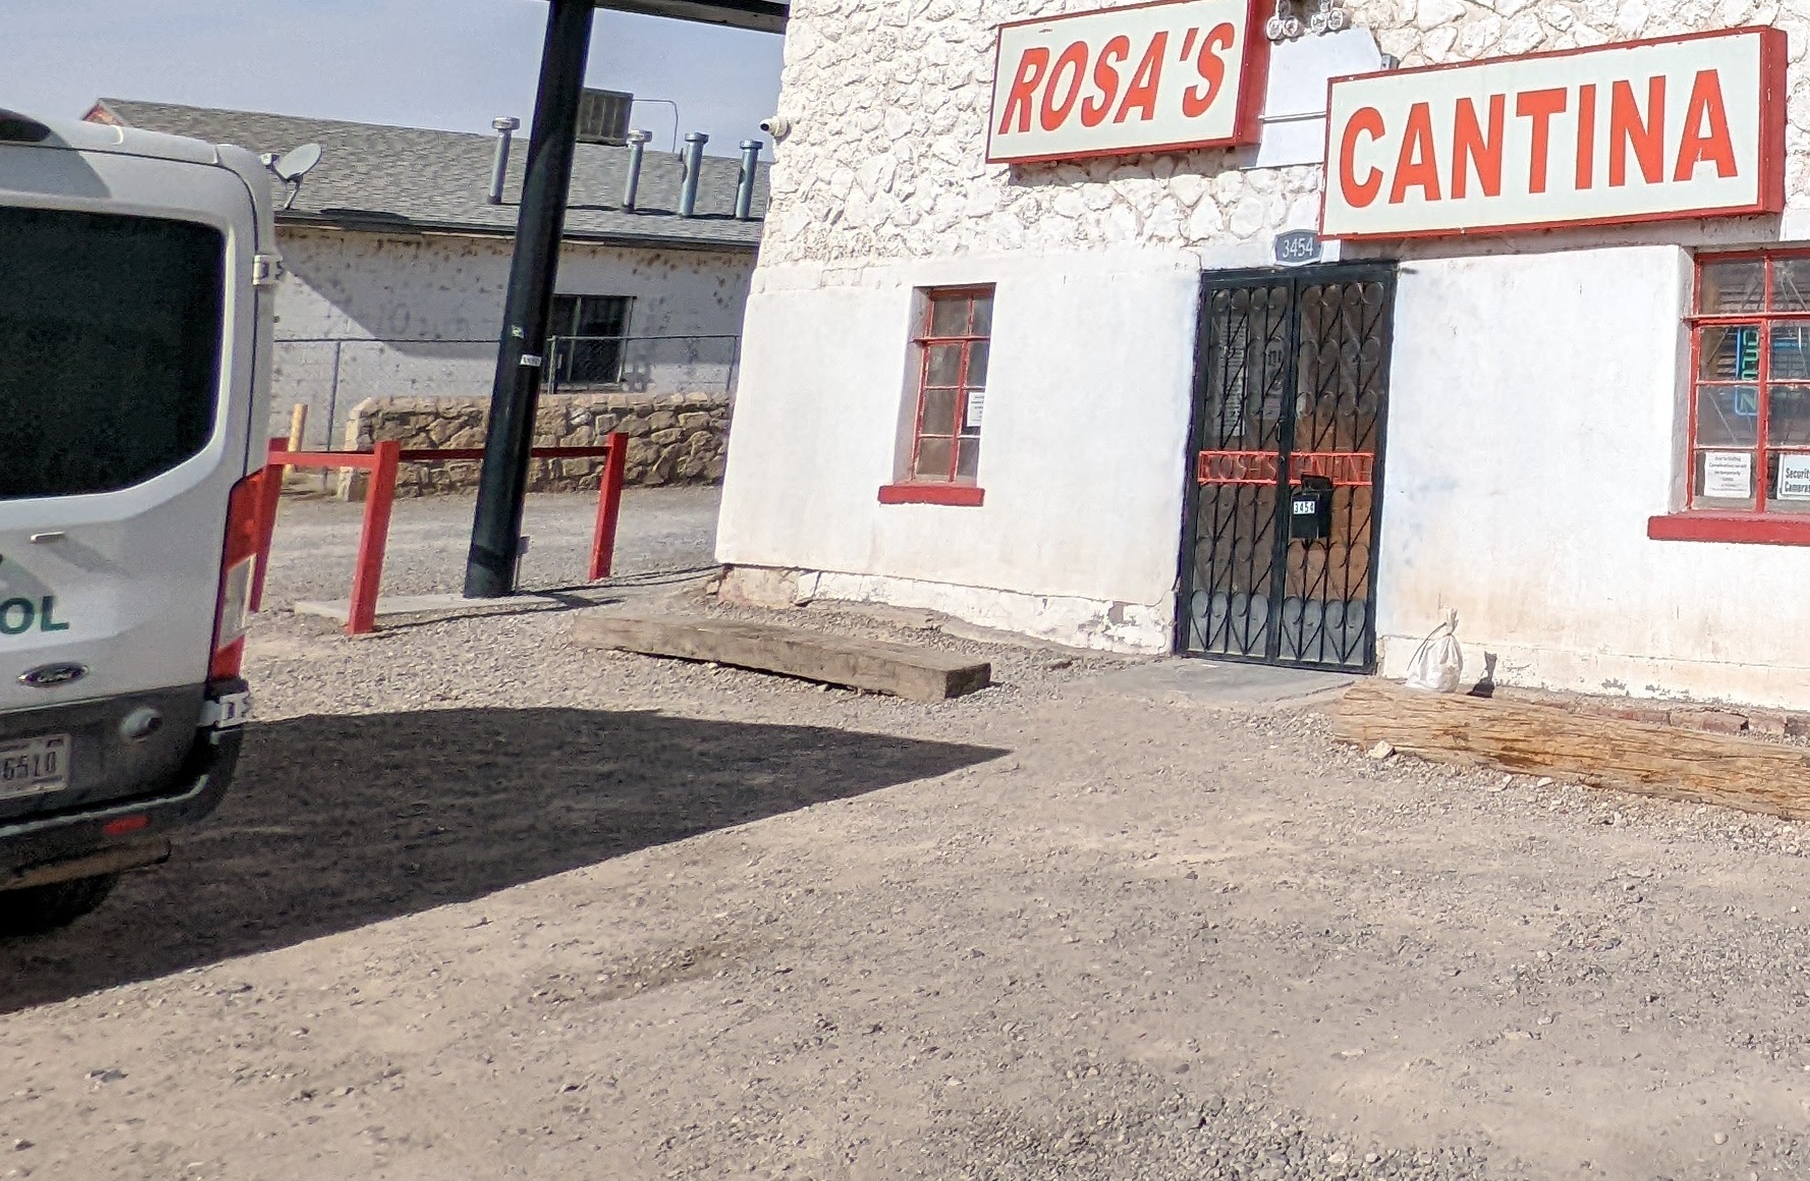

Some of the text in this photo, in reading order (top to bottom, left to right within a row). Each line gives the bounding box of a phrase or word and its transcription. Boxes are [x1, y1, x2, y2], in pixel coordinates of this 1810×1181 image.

[997, 22, 1235, 135] ROSA'S
[1339, 68, 1739, 208] CANTINA
[1282, 236, 1314, 259] 3454
[1294, 501, 1315, 514] 3454
